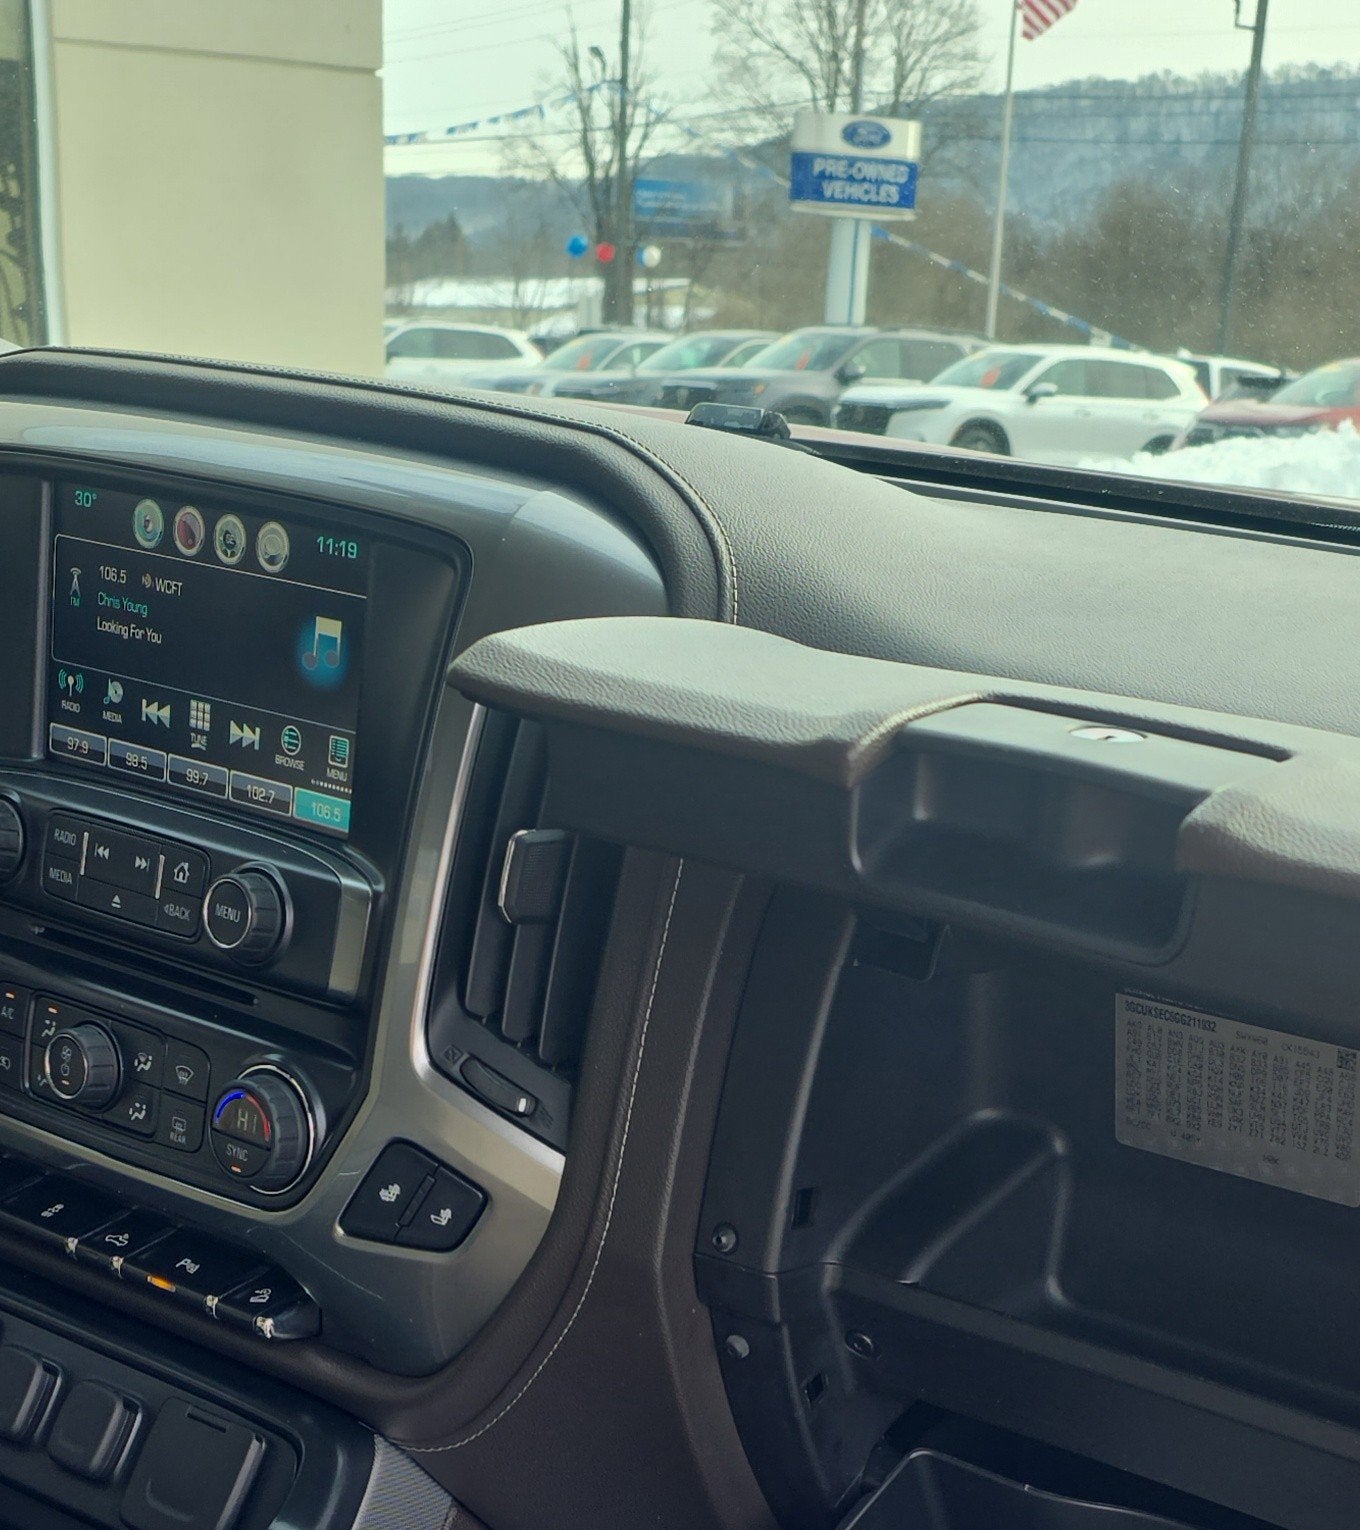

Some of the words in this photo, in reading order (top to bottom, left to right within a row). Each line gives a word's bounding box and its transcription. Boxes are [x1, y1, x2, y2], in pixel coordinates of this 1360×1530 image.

[316, 535, 358, 559] 11:19
[99, 565, 127, 584] 106.5
[97, 591, 120, 609] Chris
[122, 597, 148, 618] Young
[97, 616, 129, 640] Looking
[129, 623, 145, 639] For
[145, 626, 162, 644] You
[61, 699, 81, 713] RADIO
[102, 710, 123, 725] MEDIA
[67, 736, 89, 754] 97.9
[125, 751, 149, 771] 98.5
[275, 754, 306, 772] BROWSE
[186, 768, 209, 786] 99.7
[326, 767, 348, 782] MENU
[247, 784, 276, 804] 102.7
[312, 801, 341, 822] 106.5
[53, 828, 77, 846] RADIO
[49, 867, 73, 885] MEDIA
[168, 903, 191, 921] BACK
[214, 903, 241, 923] MENU
[226, 1143, 248, 1162] SYNC
